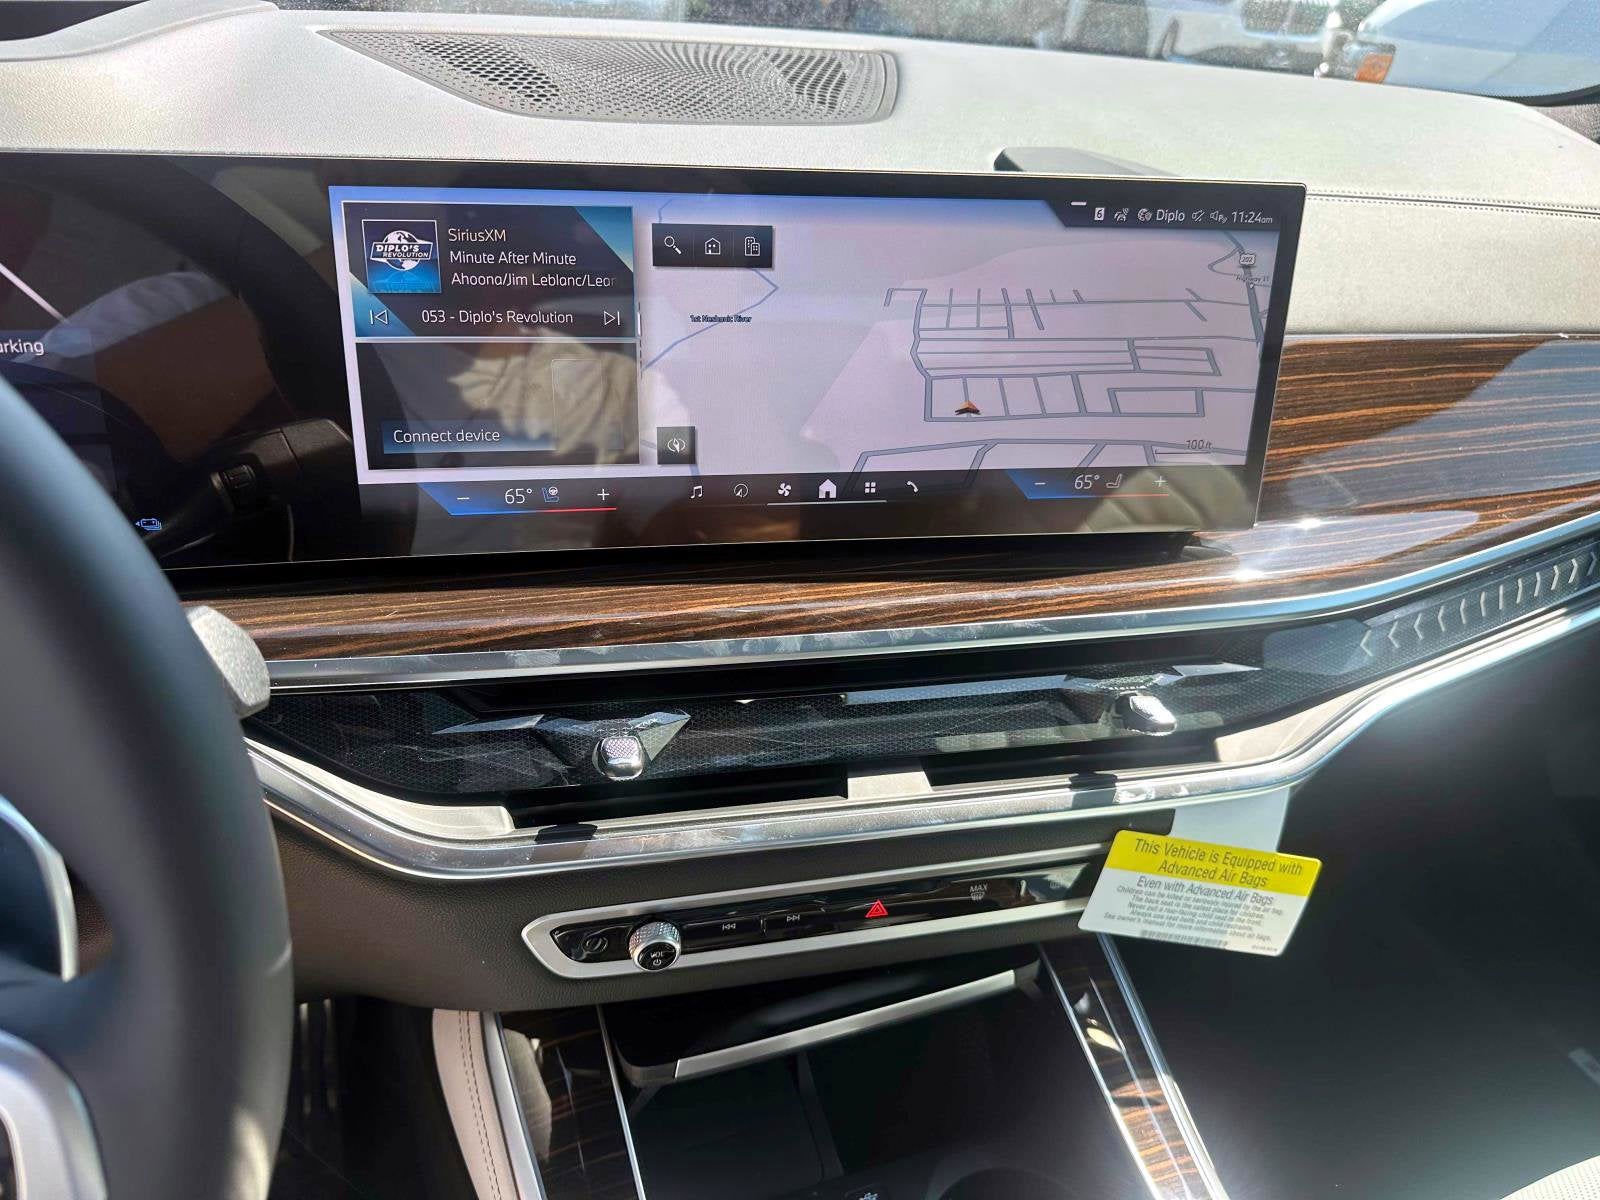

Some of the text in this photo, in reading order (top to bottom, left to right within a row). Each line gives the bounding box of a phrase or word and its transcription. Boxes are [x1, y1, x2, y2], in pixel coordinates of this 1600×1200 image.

[1156, 209, 1185, 222] Diplo
[1232, 211, 1272, 223] 11:24am
[448, 228, 506, 242] SiriusXM
[450, 251, 576, 265] Minute After Minute
[422, 310, 446, 323] 053
[459, 310, 502, 325] Diplo's
[507, 311, 573, 324] Revolution
[393, 429, 500, 443] Connect device
[1134, 839, 1303, 876] This Vehicle is Equipped with
[1158, 860, 1269, 888] Advanced Air Bags
[969, 884, 988, 892] MAX
[1137, 876, 1274, 905] Even with Advanced Air Bags
